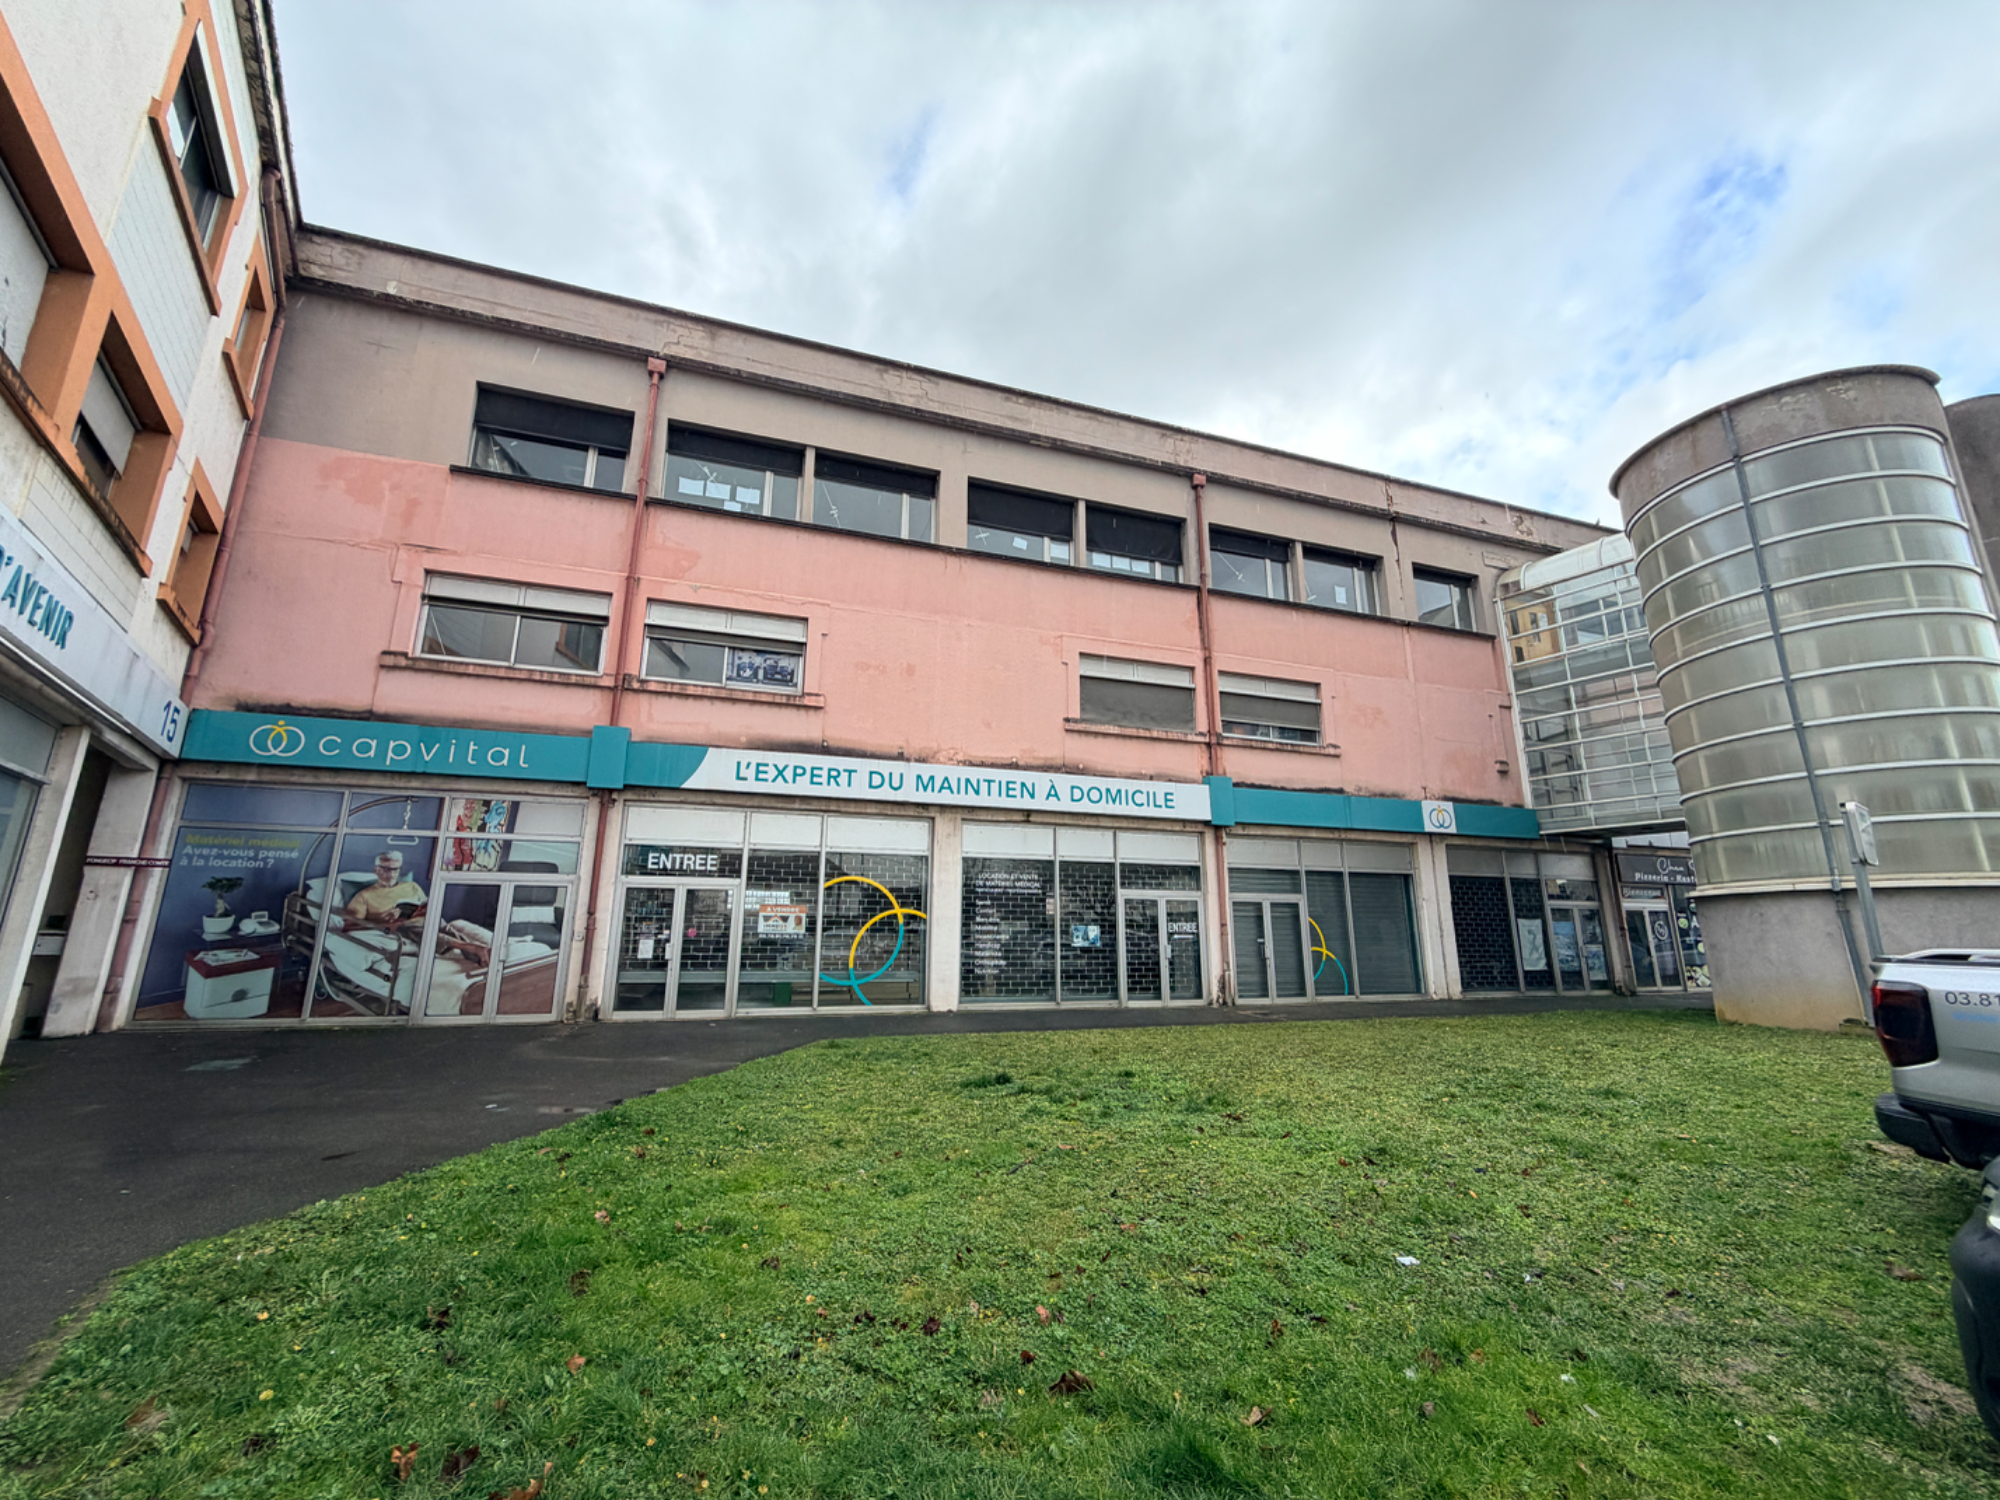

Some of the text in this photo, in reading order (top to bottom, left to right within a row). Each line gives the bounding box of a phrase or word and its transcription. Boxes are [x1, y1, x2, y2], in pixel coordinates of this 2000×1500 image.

[161, 700, 181, 743] 15
[318, 735, 529, 768] capvital
[735, 760, 1176, 809] L'EXPERT DU MAINTIEN À DOMICILE
[186, 833, 245, 846] Matériel
[182, 844, 299, 860] Avez-vous pensé
[179, 855, 275, 868] à la location ?
[647, 851, 718, 871] ENTREE
[1019, 873, 1039, 881] VENTE
[1634, 871, 1669, 882] Pizzeria
[1168, 922, 1198, 933] ENTREE
